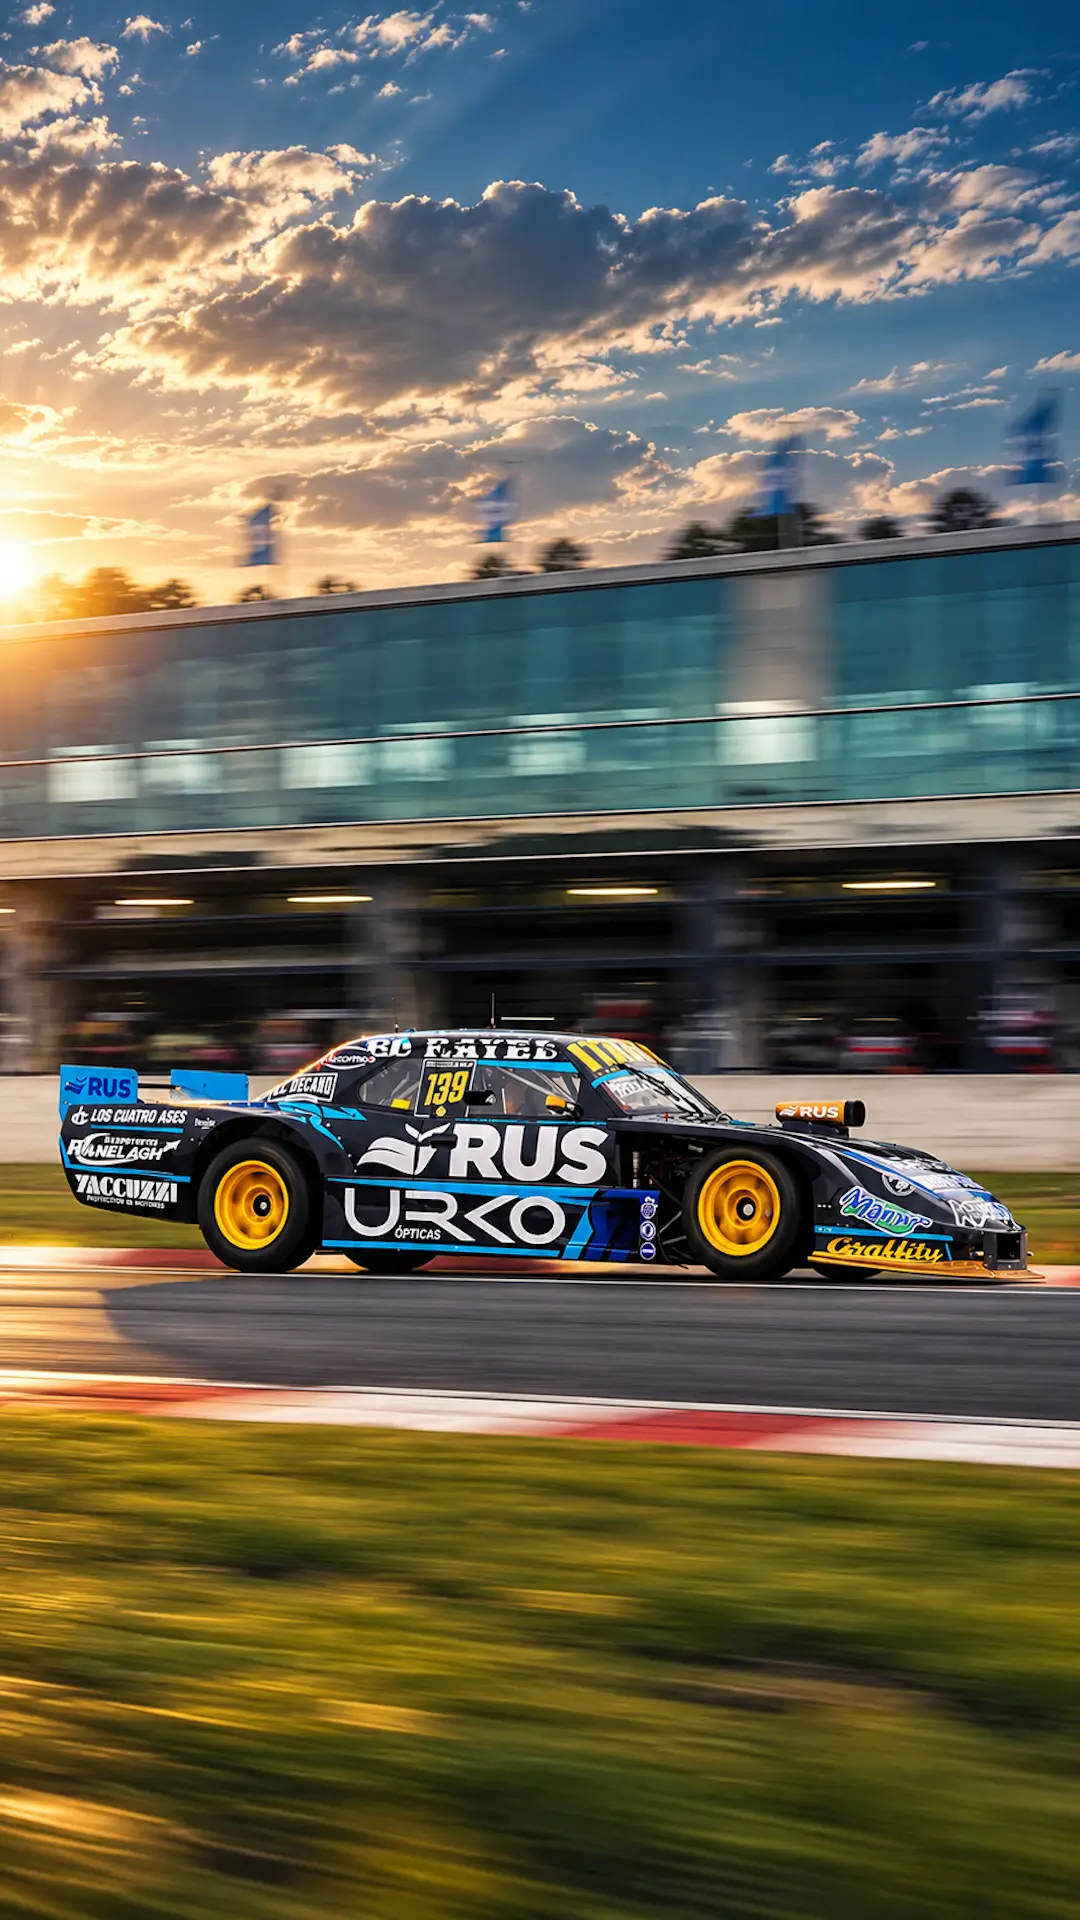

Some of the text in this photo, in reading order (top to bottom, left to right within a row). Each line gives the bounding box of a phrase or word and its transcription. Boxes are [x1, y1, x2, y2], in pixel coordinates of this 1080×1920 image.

[88, 1077, 132, 1098] RUS
[289, 1076, 334, 1095] DECANO
[423, 1070, 469, 1106] 139
[90, 1108, 111, 1122] LOS
[113, 1108, 157, 1123] CUATRO
[157, 1109, 188, 1124] ASES
[799, 1106, 839, 1118] RUS
[67, 1137, 165, 1161] RANELAGH
[448, 1123, 609, 1185] RUS
[344, 1187, 566, 1245] URKO
[394, 1225, 441, 1240] ÓPTICAS
